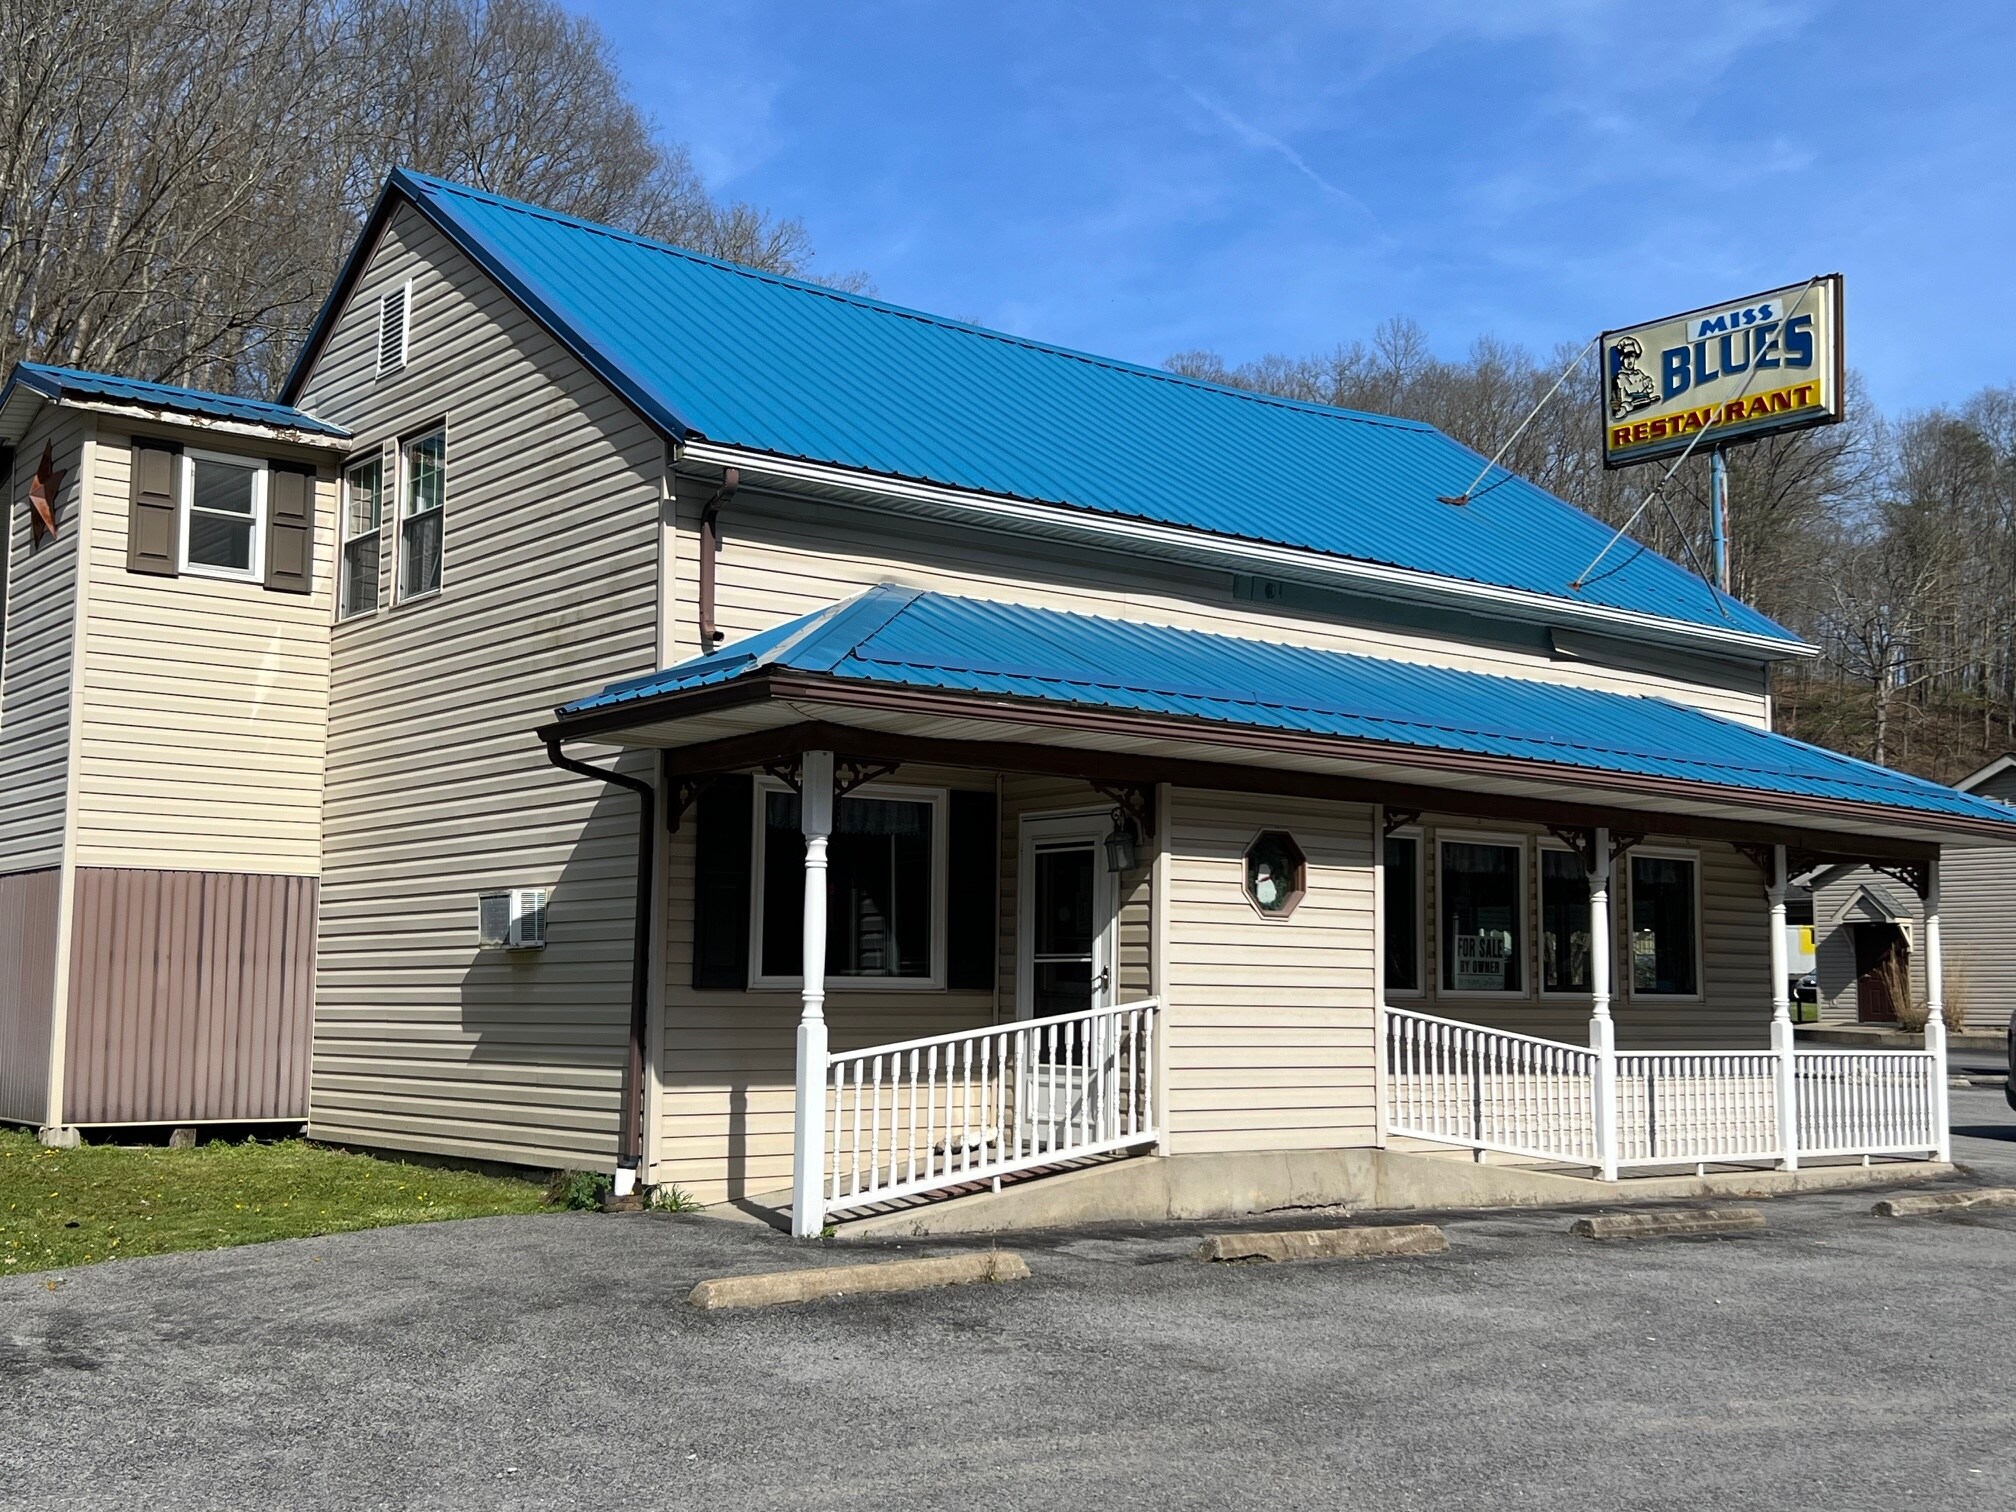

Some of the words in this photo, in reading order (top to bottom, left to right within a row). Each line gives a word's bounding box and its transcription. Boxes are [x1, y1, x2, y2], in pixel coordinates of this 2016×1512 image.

[1698, 304, 1774, 337] MISS
[1662, 314, 1813, 400] BLUES
[1613, 385, 1812, 446] RESTAURANT
[1457, 937, 1476, 958] FOR
[1479, 938, 1503, 958] SALE
[1460, 960, 1470, 973] BY
[1472, 960, 1500, 974] OWNER
